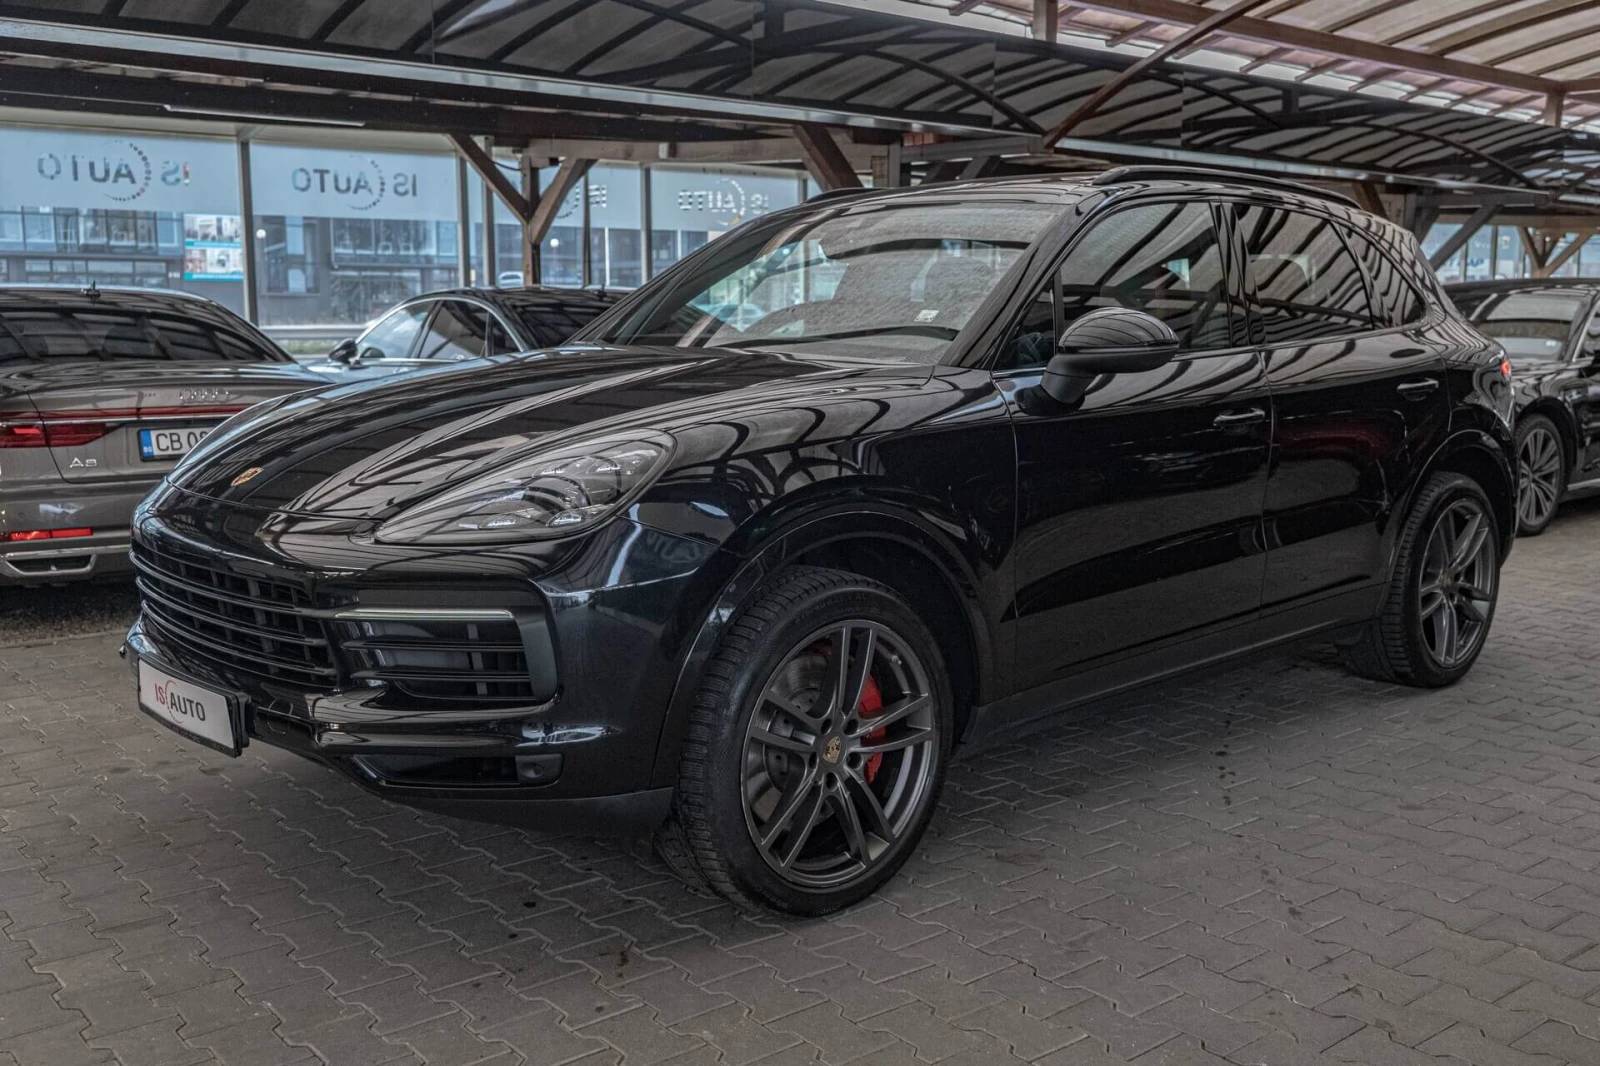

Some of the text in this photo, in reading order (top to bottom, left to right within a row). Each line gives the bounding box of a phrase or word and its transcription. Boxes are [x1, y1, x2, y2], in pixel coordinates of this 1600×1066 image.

[156, 432, 183, 452] CB
[154, 683, 206, 722] IS AUTO
